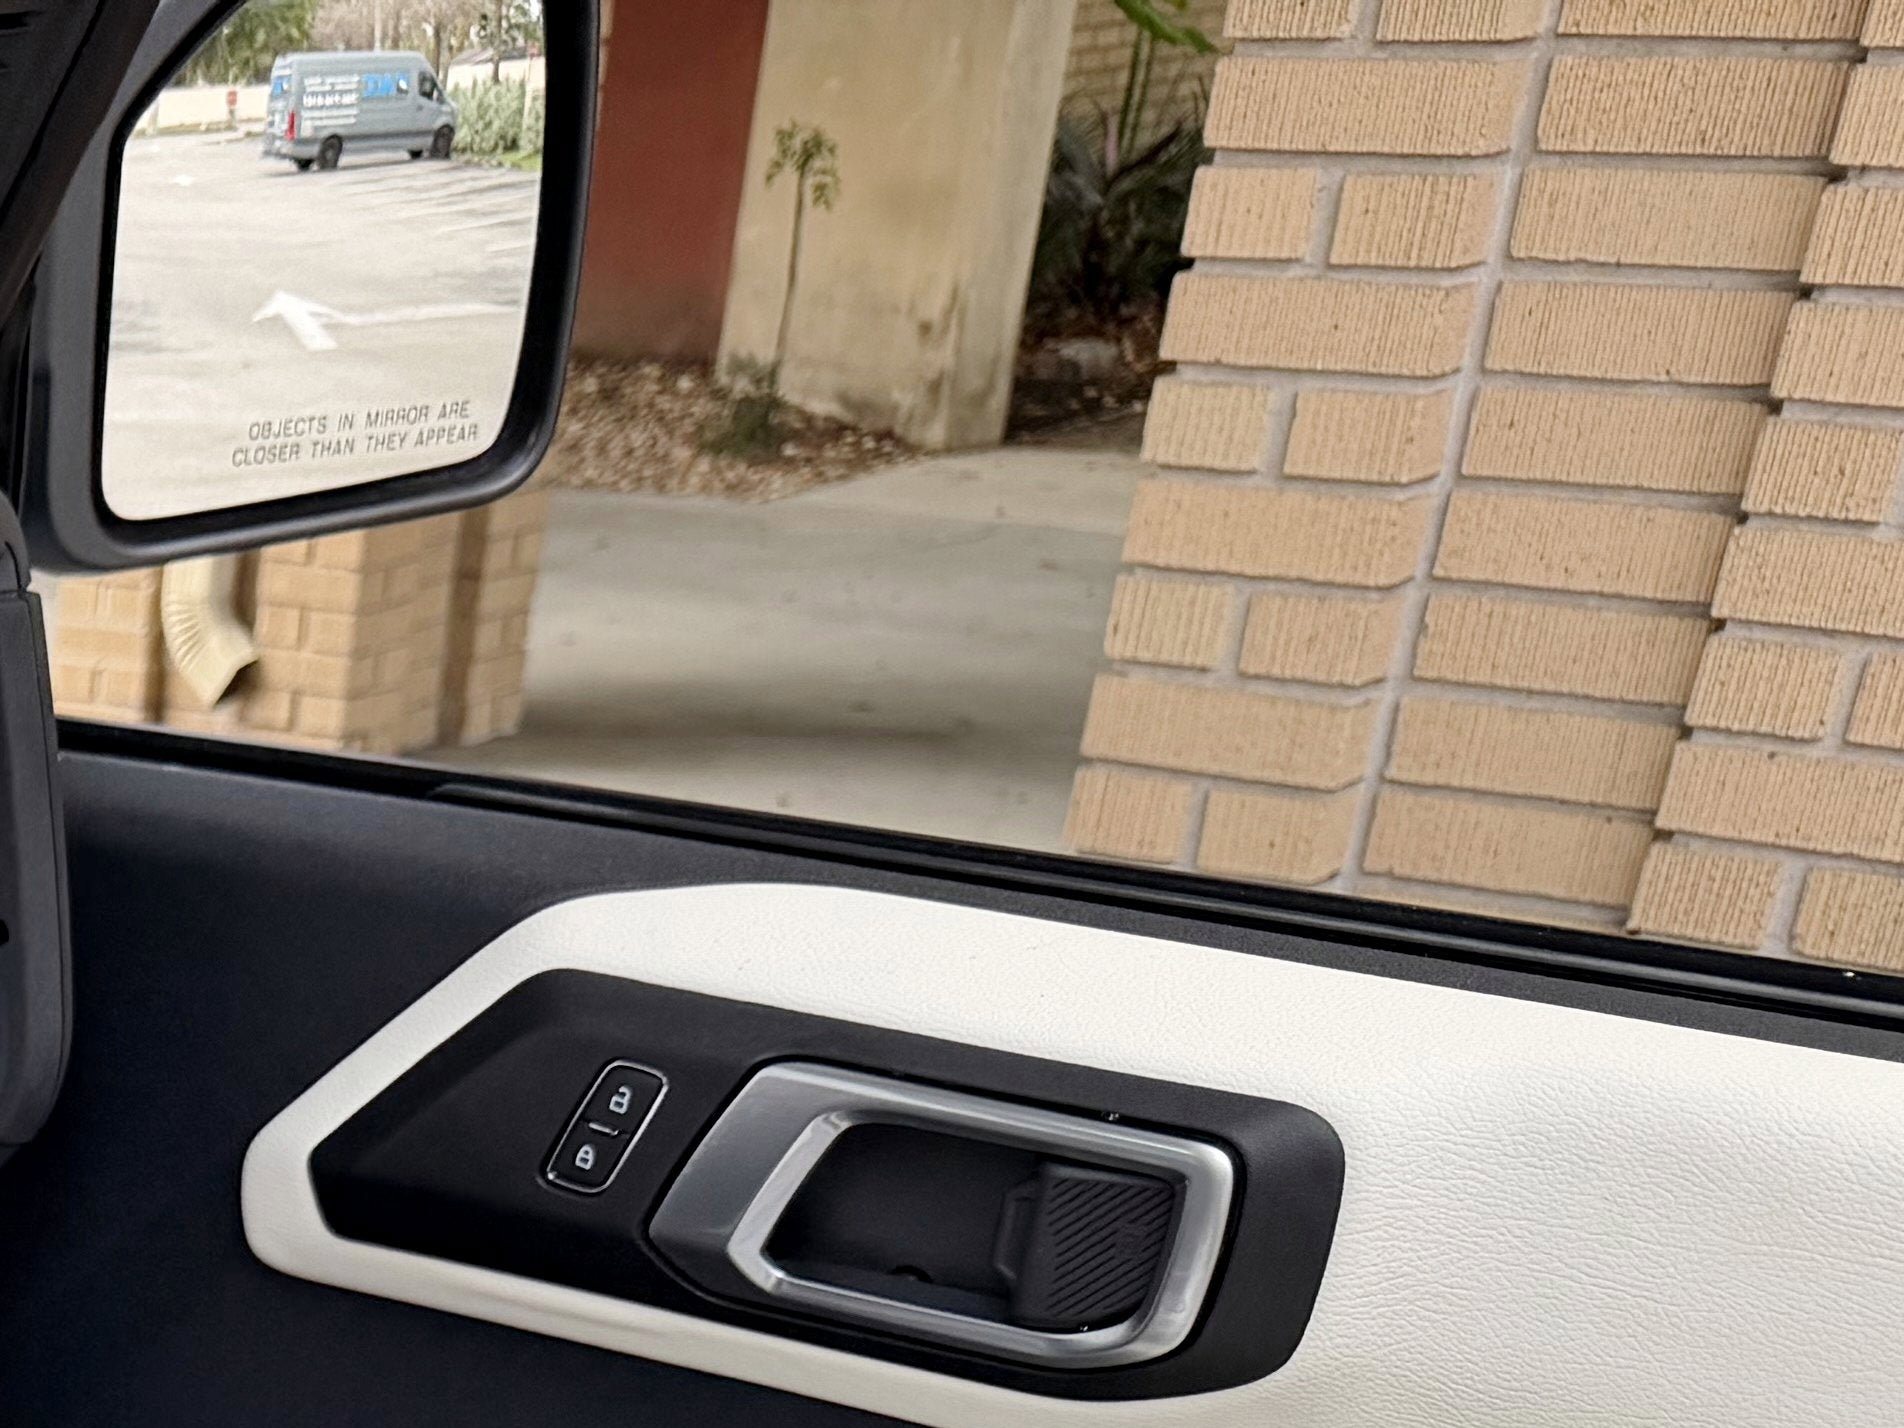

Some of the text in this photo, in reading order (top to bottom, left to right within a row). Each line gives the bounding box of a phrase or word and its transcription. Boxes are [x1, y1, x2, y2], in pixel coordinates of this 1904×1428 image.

[248, 400, 470, 441] OBJECTS IN MIRROR ARE
[232, 423, 479, 467] CLOSER THAN THEY APPEAR
